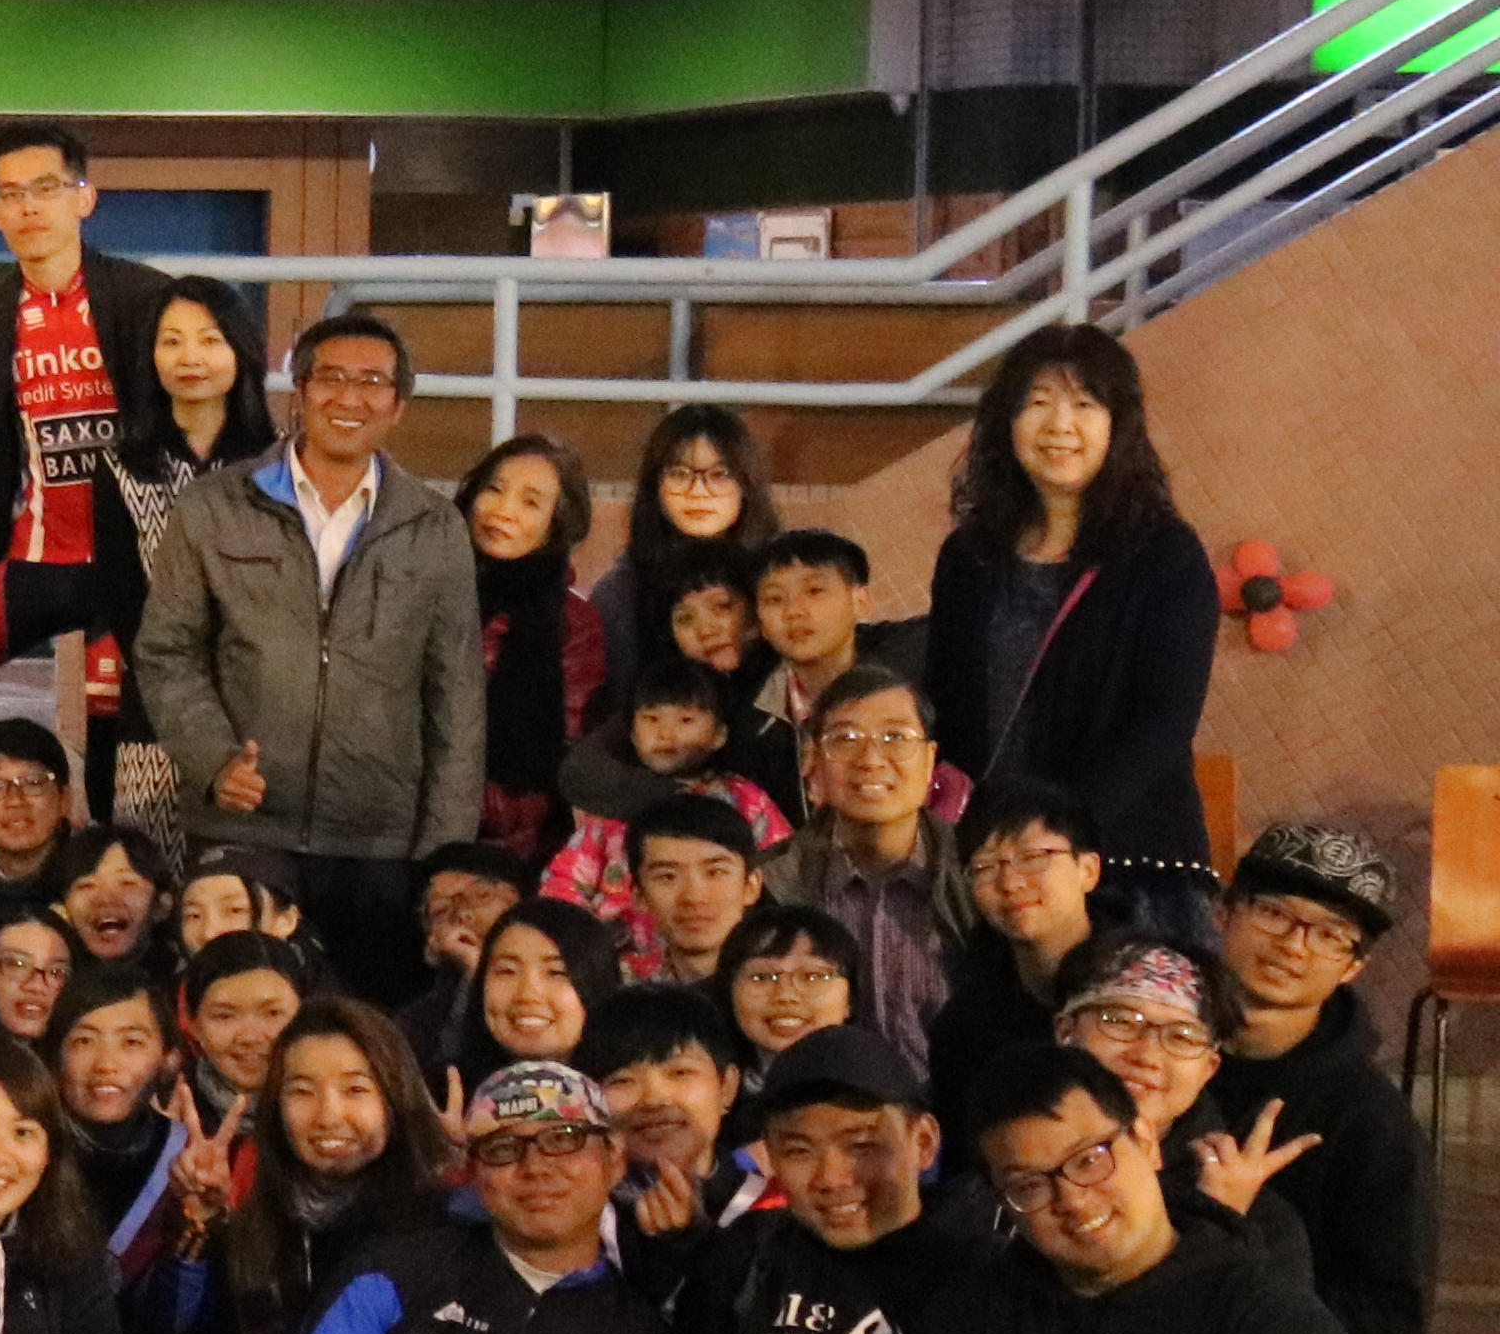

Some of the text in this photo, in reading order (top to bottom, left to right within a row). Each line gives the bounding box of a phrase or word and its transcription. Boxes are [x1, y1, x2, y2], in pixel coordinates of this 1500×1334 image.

[12, 343, 104, 383] Tinko
[16, 380, 115, 407] redit Syste
[40, 419, 114, 447] SAXO
[44, 453, 97, 479] BAN
